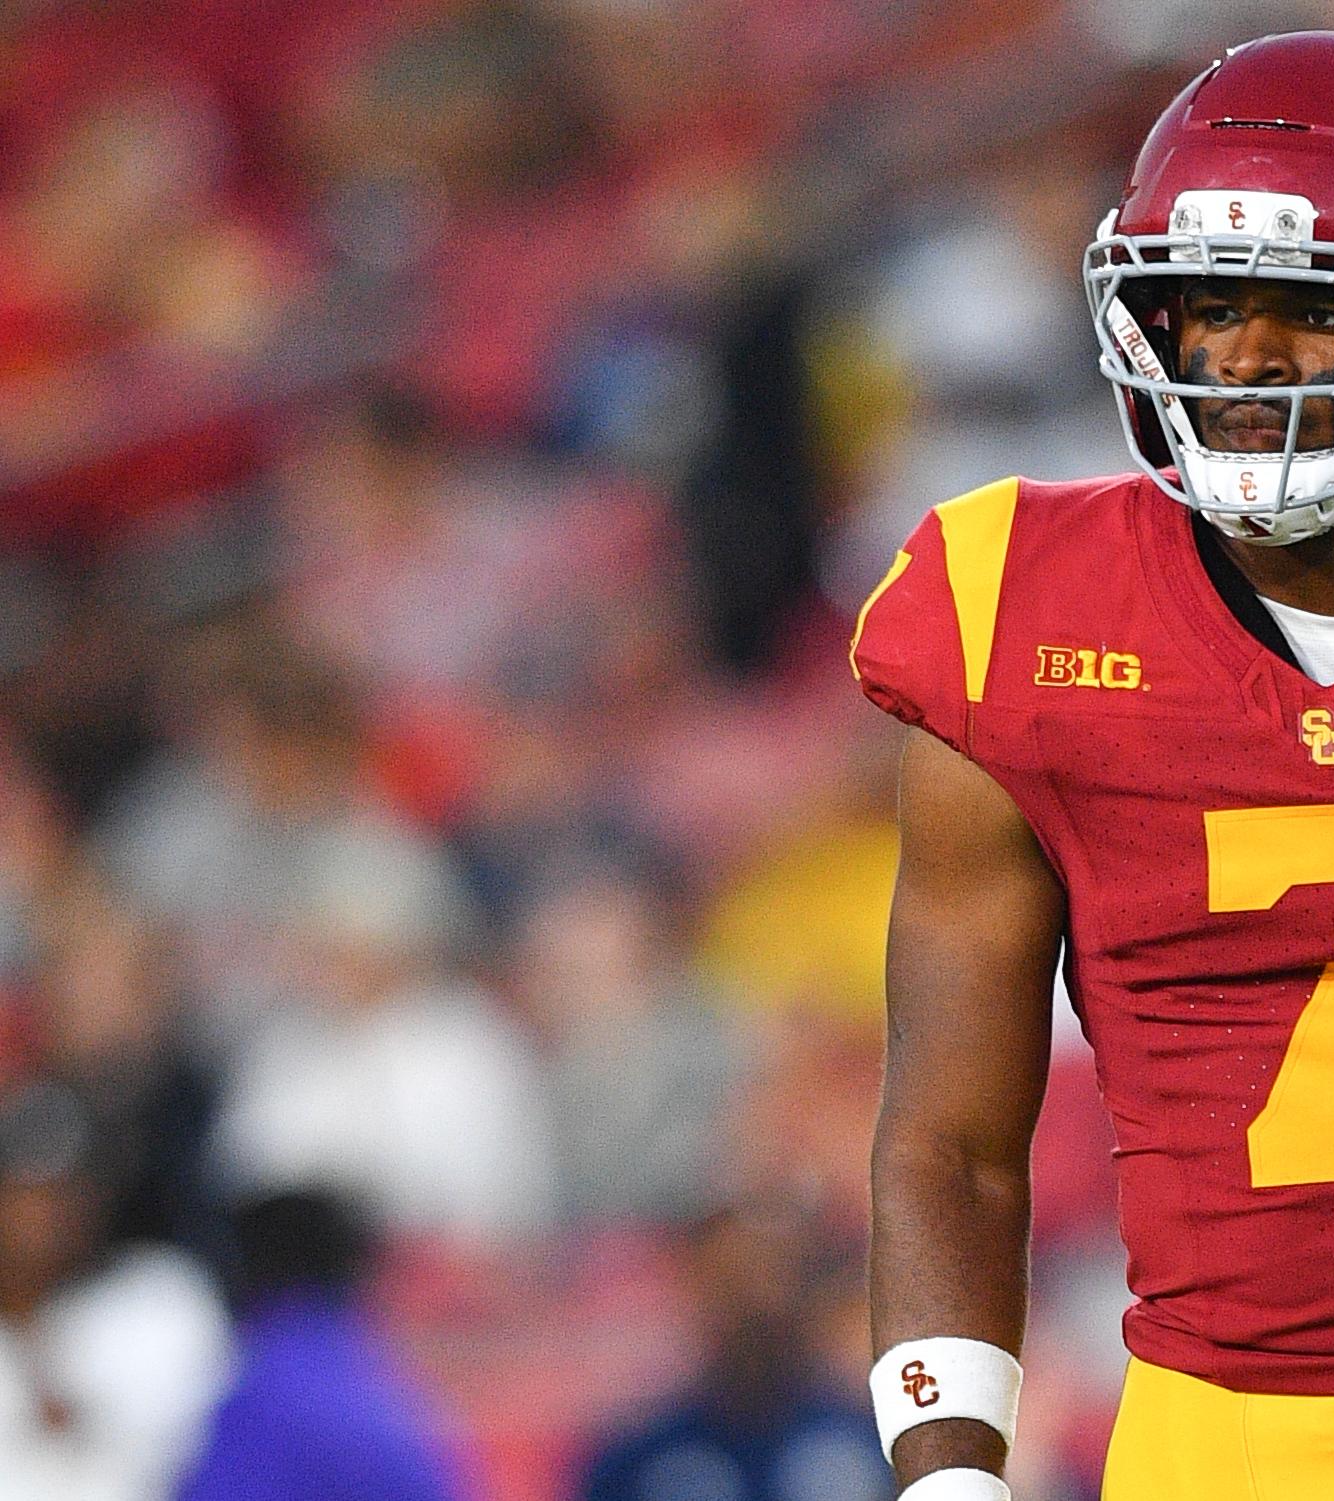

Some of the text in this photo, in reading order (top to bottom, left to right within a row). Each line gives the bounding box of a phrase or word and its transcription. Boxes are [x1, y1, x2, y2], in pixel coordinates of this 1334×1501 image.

[1228, 201, 1246, 230] SC
[1118, 318, 1176, 409] TROJAS
[1239, 471, 1258, 502] SC
[901, 1360, 940, 1409] SC
